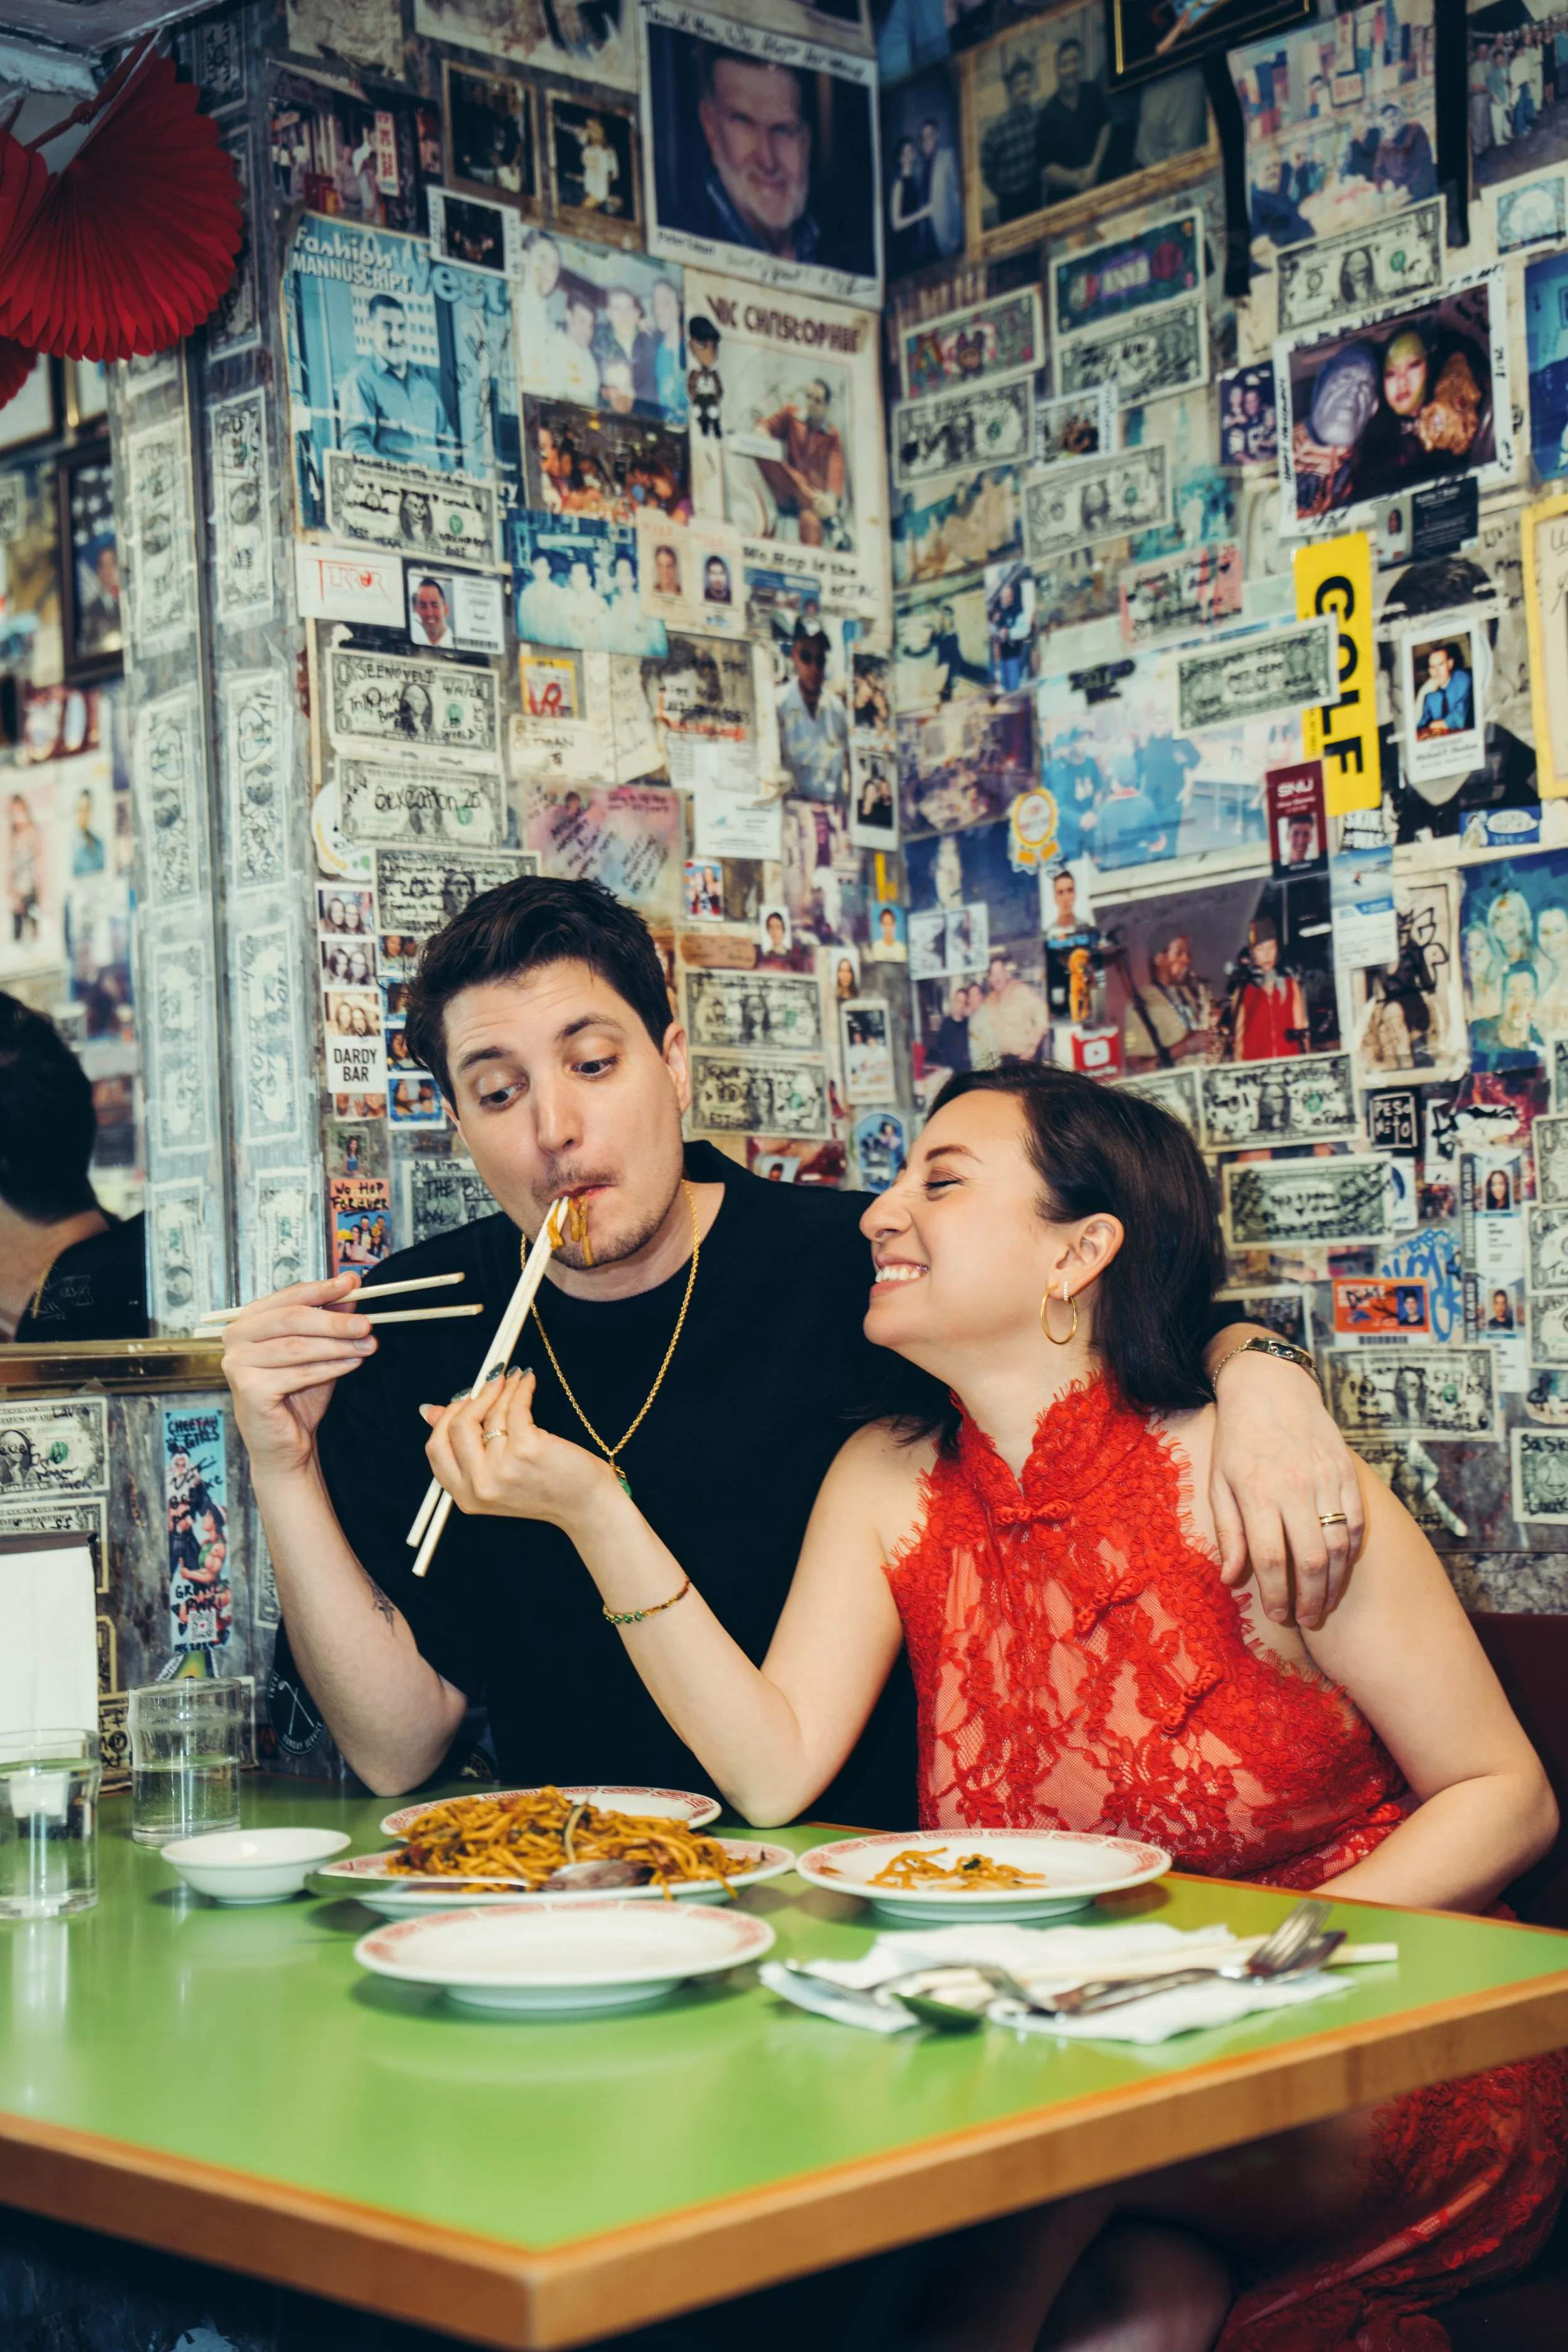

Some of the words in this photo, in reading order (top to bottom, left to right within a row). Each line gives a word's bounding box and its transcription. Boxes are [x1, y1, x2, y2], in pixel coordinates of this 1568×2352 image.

[295, 226, 395, 272] Fashion
[292, 252, 411, 294] MANNUSCRIPT
[305, 558, 395, 607] TERROR
[1315, 575, 1364, 774] GOLF
[334, 1047, 378, 1064] DARDY
[342, 1066, 369, 1083] BAR
[334, 1182, 351, 1195] Wo
[167, 1416, 218, 1436] CHEETAH
[184, 1430, 220, 1449] GIRLS
[282, 1733, 303, 1751] SUNDAY
